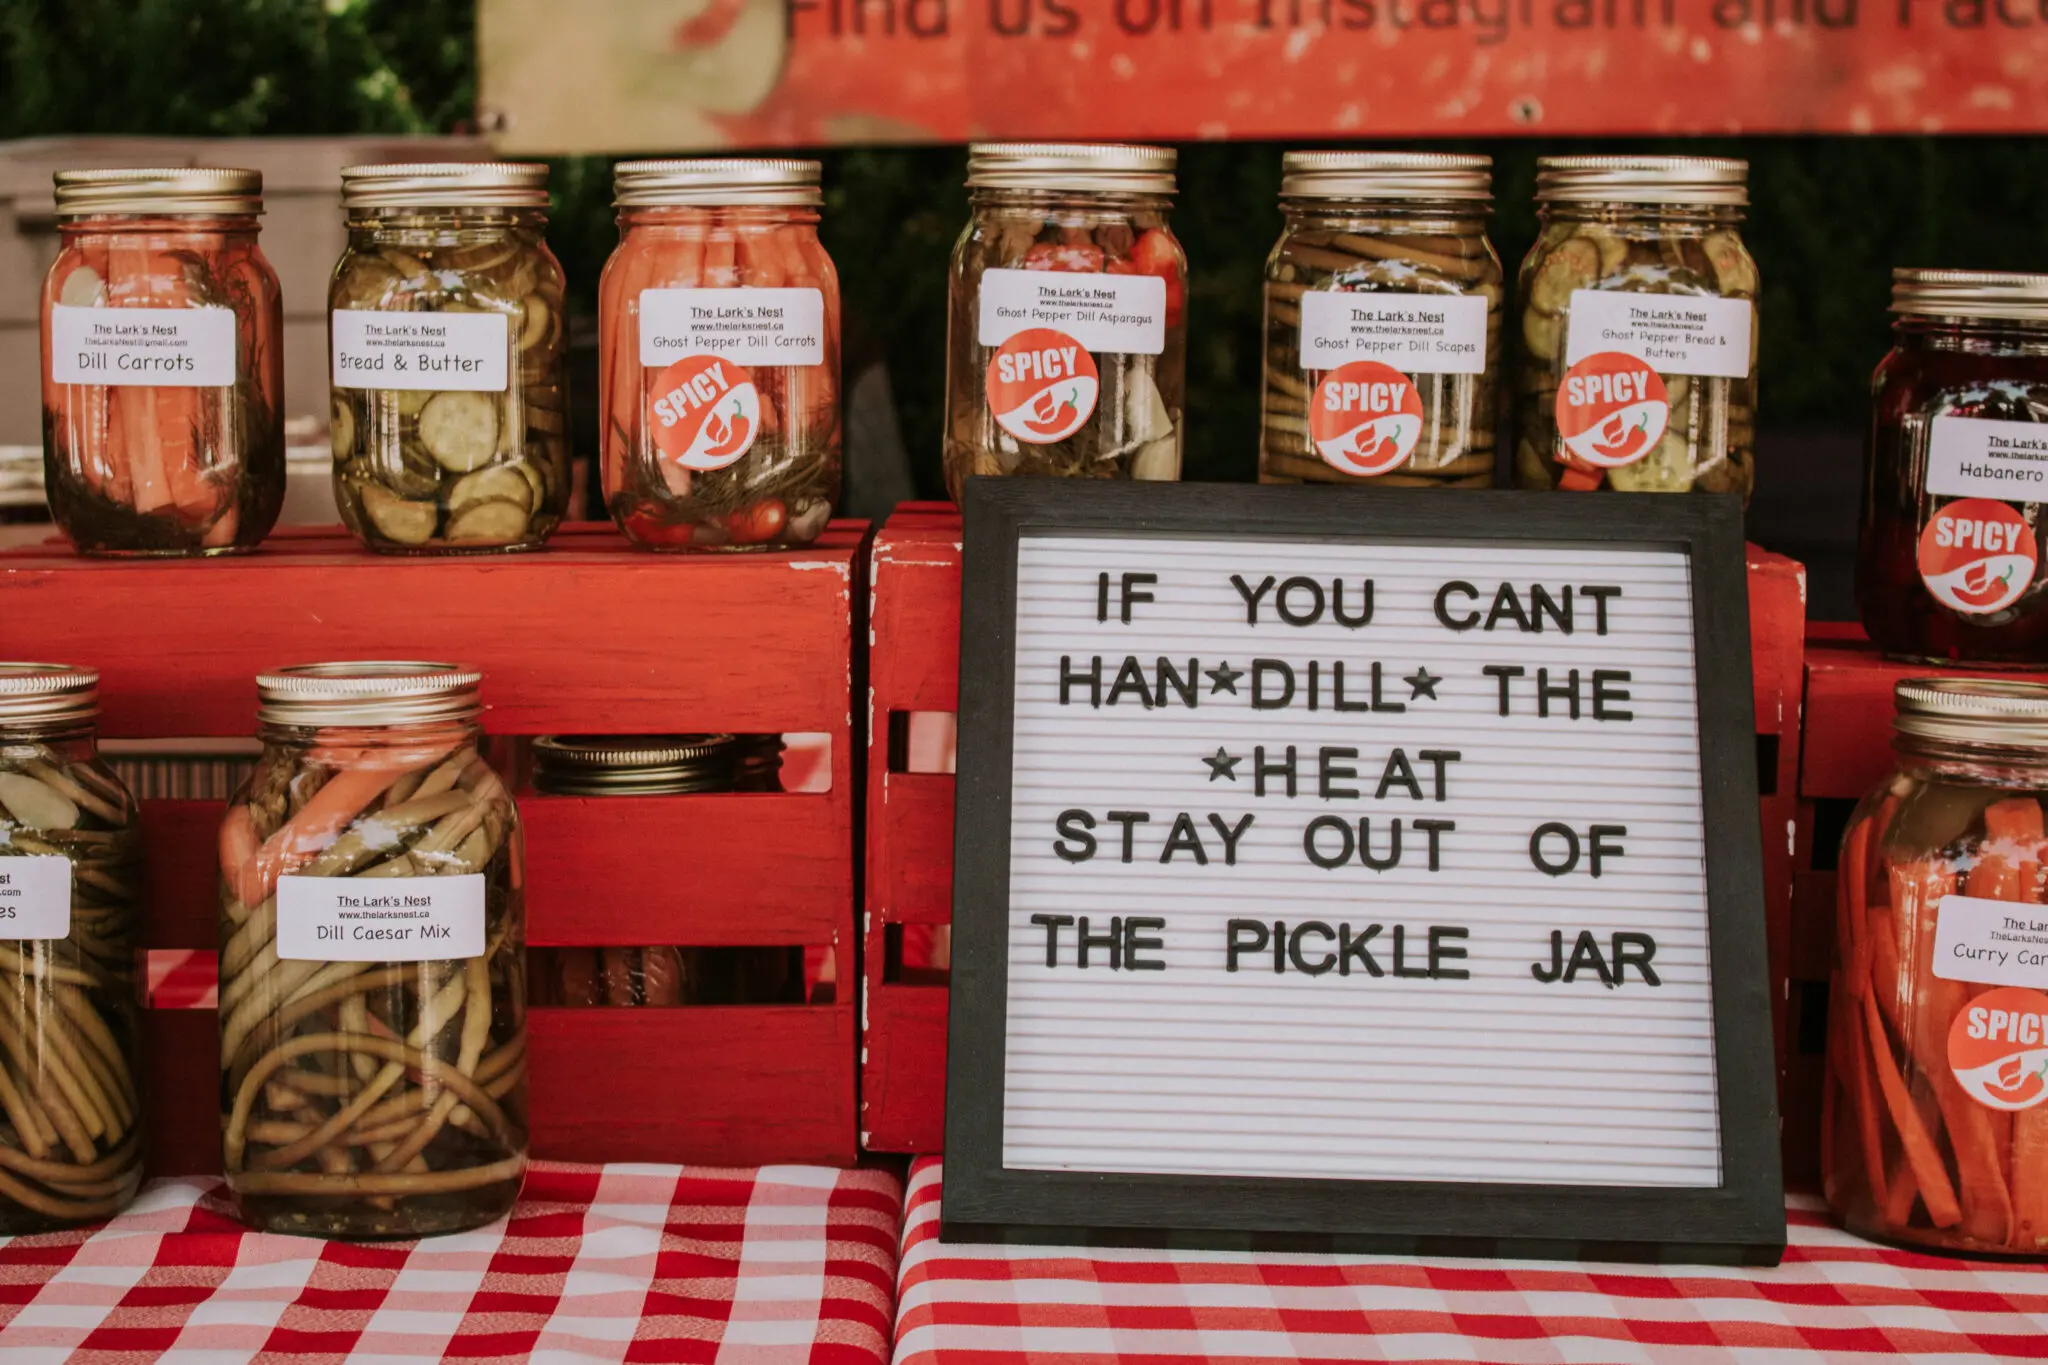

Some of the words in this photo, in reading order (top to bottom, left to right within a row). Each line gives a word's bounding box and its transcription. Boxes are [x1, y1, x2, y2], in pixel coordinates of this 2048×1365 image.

[1038, 287, 1057, 297] The
[1059, 288, 1090, 298] Lark's
[1093, 289, 1117, 299] Nest
[690, 306, 713, 318] The
[717, 306, 754, 318] Lark's
[757, 307, 784, 318] Nest
[997, 307, 1027, 318] Ghost
[1032, 308, 1072, 321] Pepper
[1077, 311, 1095, 321] Dill
[1099, 312, 1153, 326] Asparagus
[1350, 309, 1373, 321] The
[1377, 310, 1414, 322] Lark's
[1418, 311, 1445, 323] Nest
[1629, 308, 1649, 318] The
[1651, 309, 1682, 320] Lark's
[1685, 311, 1708, 322] Nest
[93, 323, 112, 335] The
[115, 324, 149, 335] Lark's
[152, 325, 178, 336] Nest
[365, 324, 383, 335] The
[385, 325, 418, 336] Lark's
[421, 326, 447, 336] Nest
[1602, 328, 1635, 340] Ghost
[1639, 331, 1680, 346] Pepper
[1684, 333, 1716, 346] Bread
[1719, 335, 1727, 346] &
[653, 335, 688, 348] Ghost
[695, 336, 742, 350] Pepper
[747, 336, 768, 347] Dill
[774, 335, 816, 347] Carrots
[1314, 337, 1350, 349] Ghost
[1356, 338, 1403, 354] Pepper
[1409, 340, 1430, 352] Dill
[1436, 341, 1476, 355] Scapes
[78, 352, 107, 370] Dill
[117, 353, 194, 371] Carrots
[340, 352, 385, 370] Bread
[394, 353, 408, 371] &
[418, 354, 484, 372] Butter
[1645, 347, 1687, 360] Butters
[997, 346, 1077, 384] SPICY
[653, 361, 730, 428] SPICY
[1324, 381, 1407, 412] SPICY
[1567, 370, 1649, 407] SPICY
[1988, 435, 2010, 448] The
[2013, 437, 2048, 450] Lark's
[1960, 462, 2044, 482] Habanero
[1935, 516, 2023, 553] SPICY
[1095, 571, 1159, 624] IF
[1230, 574, 1375, 628] YOU
[1433, 579, 1624, 637] CANT
[1481, 664, 1634, 722] THE
[1053, 810, 1255, 867] STAY
[1303, 815, 1456, 873] OUT
[1528, 820, 1628, 878] OF
[336, 895, 360, 907] The
[363, 895, 400, 907] Lark's
[404, 895, 431, 907] Nest
[338, 910, 430, 919] www.thelarksnest.ca
[2003, 916, 2026, 930] The
[317, 925, 344, 940] Dill
[353, 926, 413, 941] Caesar
[420, 924, 451, 940] Mix
[1030, 912, 1167, 972] THE
[1226, 919, 1470, 981] PICKLE
[1530, 929, 1662, 989] JAR
[1953, 943, 2009, 967] Curry
